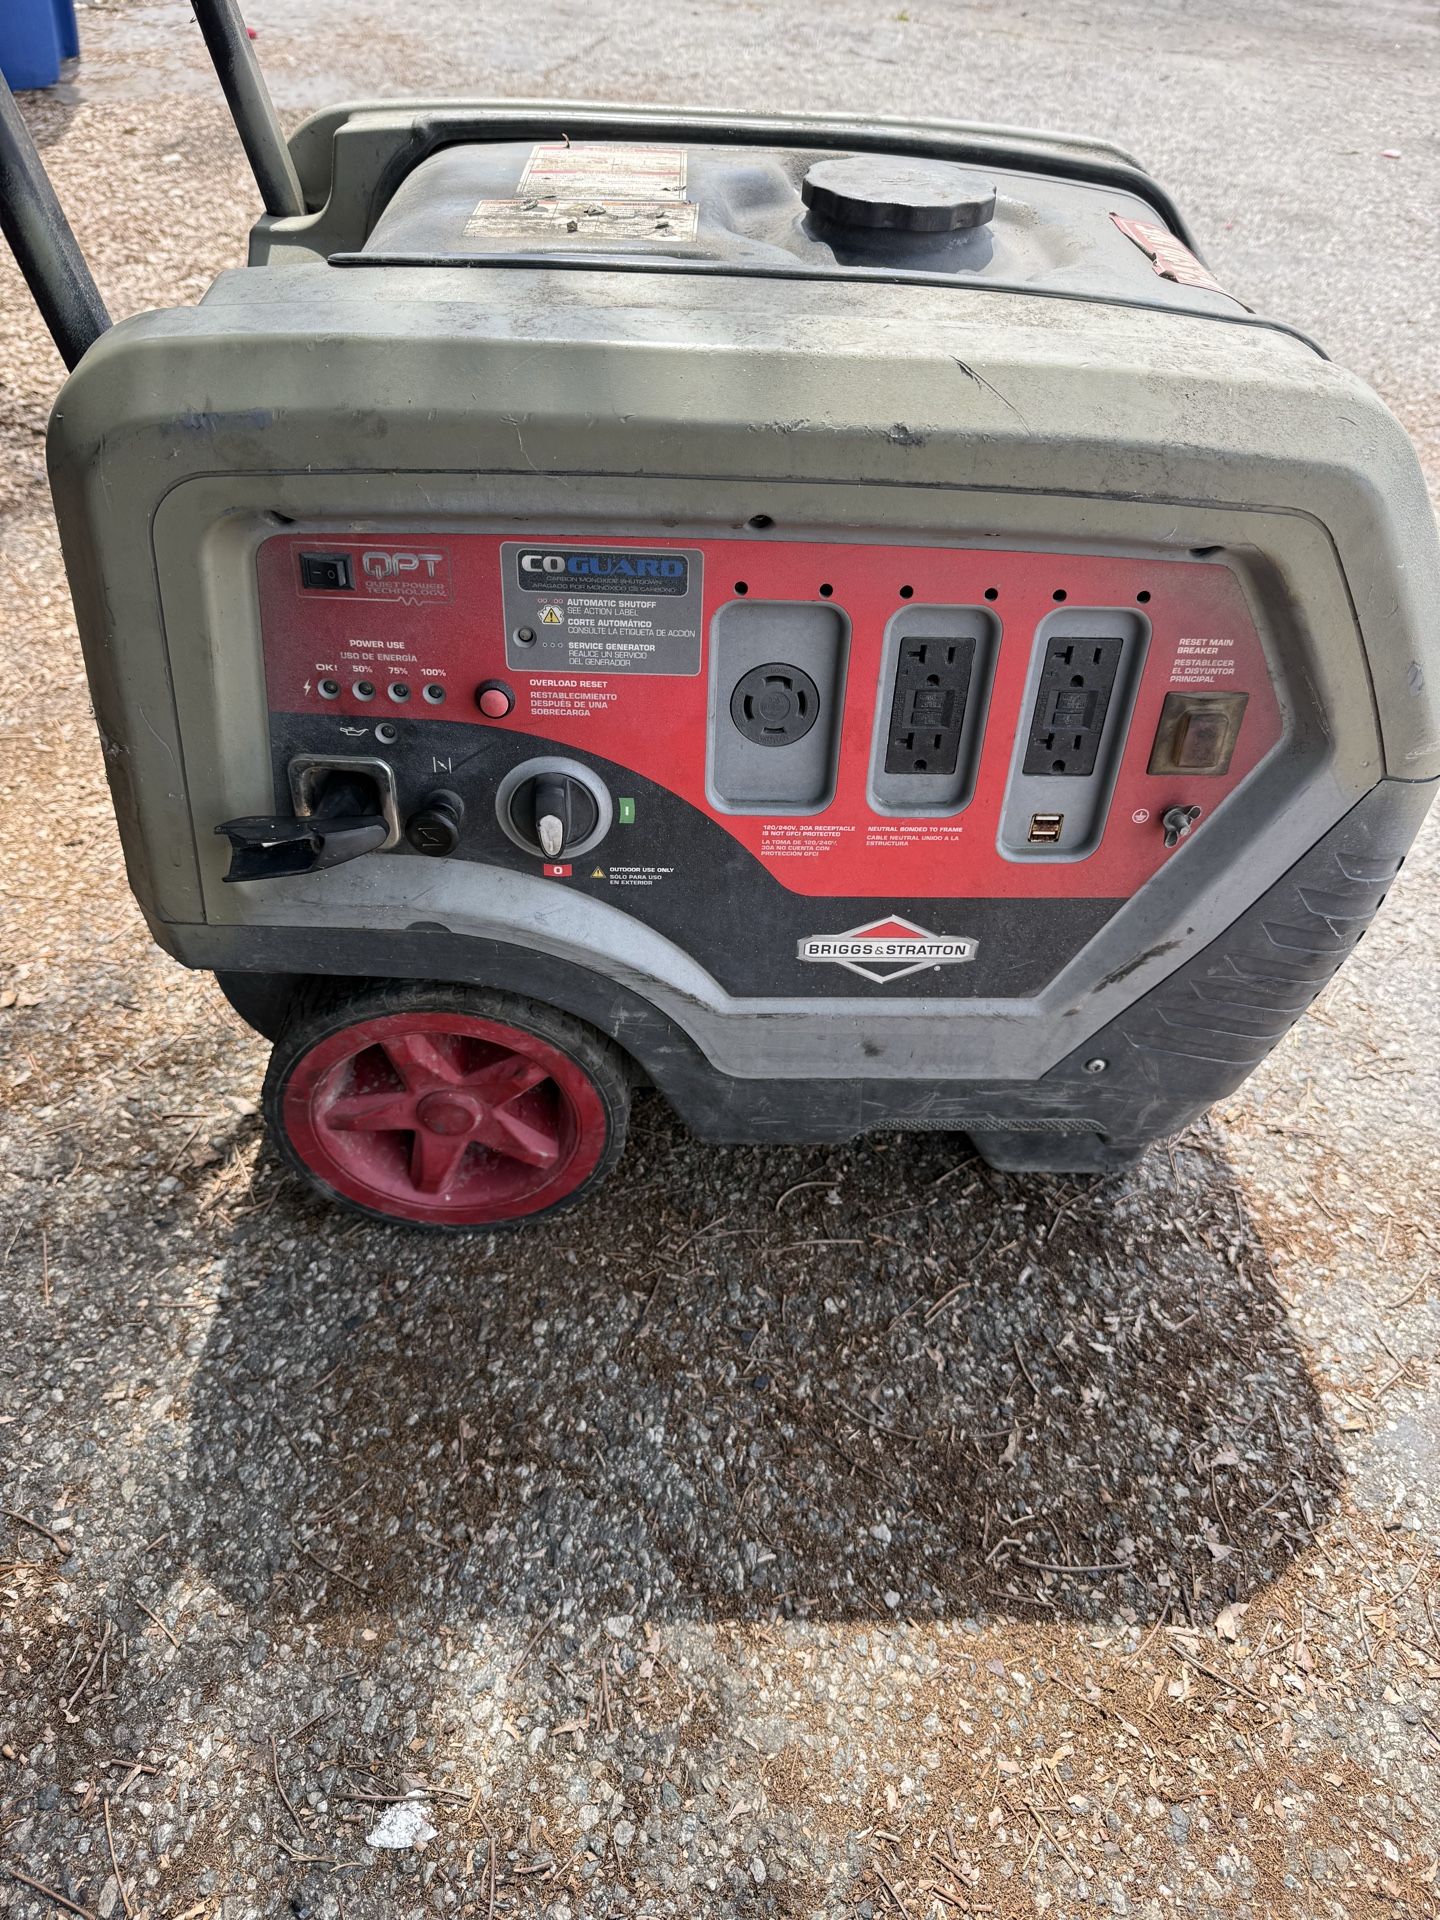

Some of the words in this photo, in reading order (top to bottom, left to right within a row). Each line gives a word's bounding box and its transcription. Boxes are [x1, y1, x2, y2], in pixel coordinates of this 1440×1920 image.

[363, 551, 443, 579] QPT
[402, 582, 445, 590] POWER
[567, 599, 616, 607] AUTOMATIC
[619, 600, 657, 609] SHUTOFF
[598, 618, 652, 628] AUTOMÁTICO
[568, 627, 606, 635] CONSULTE
[620, 628, 654, 636] ETIQUETA
[349, 640, 384, 648] POWER
[387, 641, 405, 649] USE
[568, 642, 603, 650] SERVICE
[606, 643, 656, 651] GENERATOR
[1179, 638, 1207, 646] RESET
[1209, 639, 1234, 647] MAIN
[340, 652, 360, 660] USO
[377, 653, 417, 662] ENERGÍA
[568, 650, 599, 658] REALICE
[585, 658, 631, 666] GENERADOR
[1174, 659, 1235, 667] RESTABLECER
[315, 663, 338, 671] OK!
[352, 665, 373, 673] 50%
[388, 667, 408, 675] 75%
[421, 668, 447, 677] 100%
[530, 679, 577, 687] OVERLOAD
[580, 680, 608, 688] RESET
[1169, 675, 1215, 683] PRINCIPAL
[530, 691, 617, 700] RESTABLECIMIENTO
[531, 699, 572, 708] DESPUÉS
[589, 701, 608, 709] UNA
